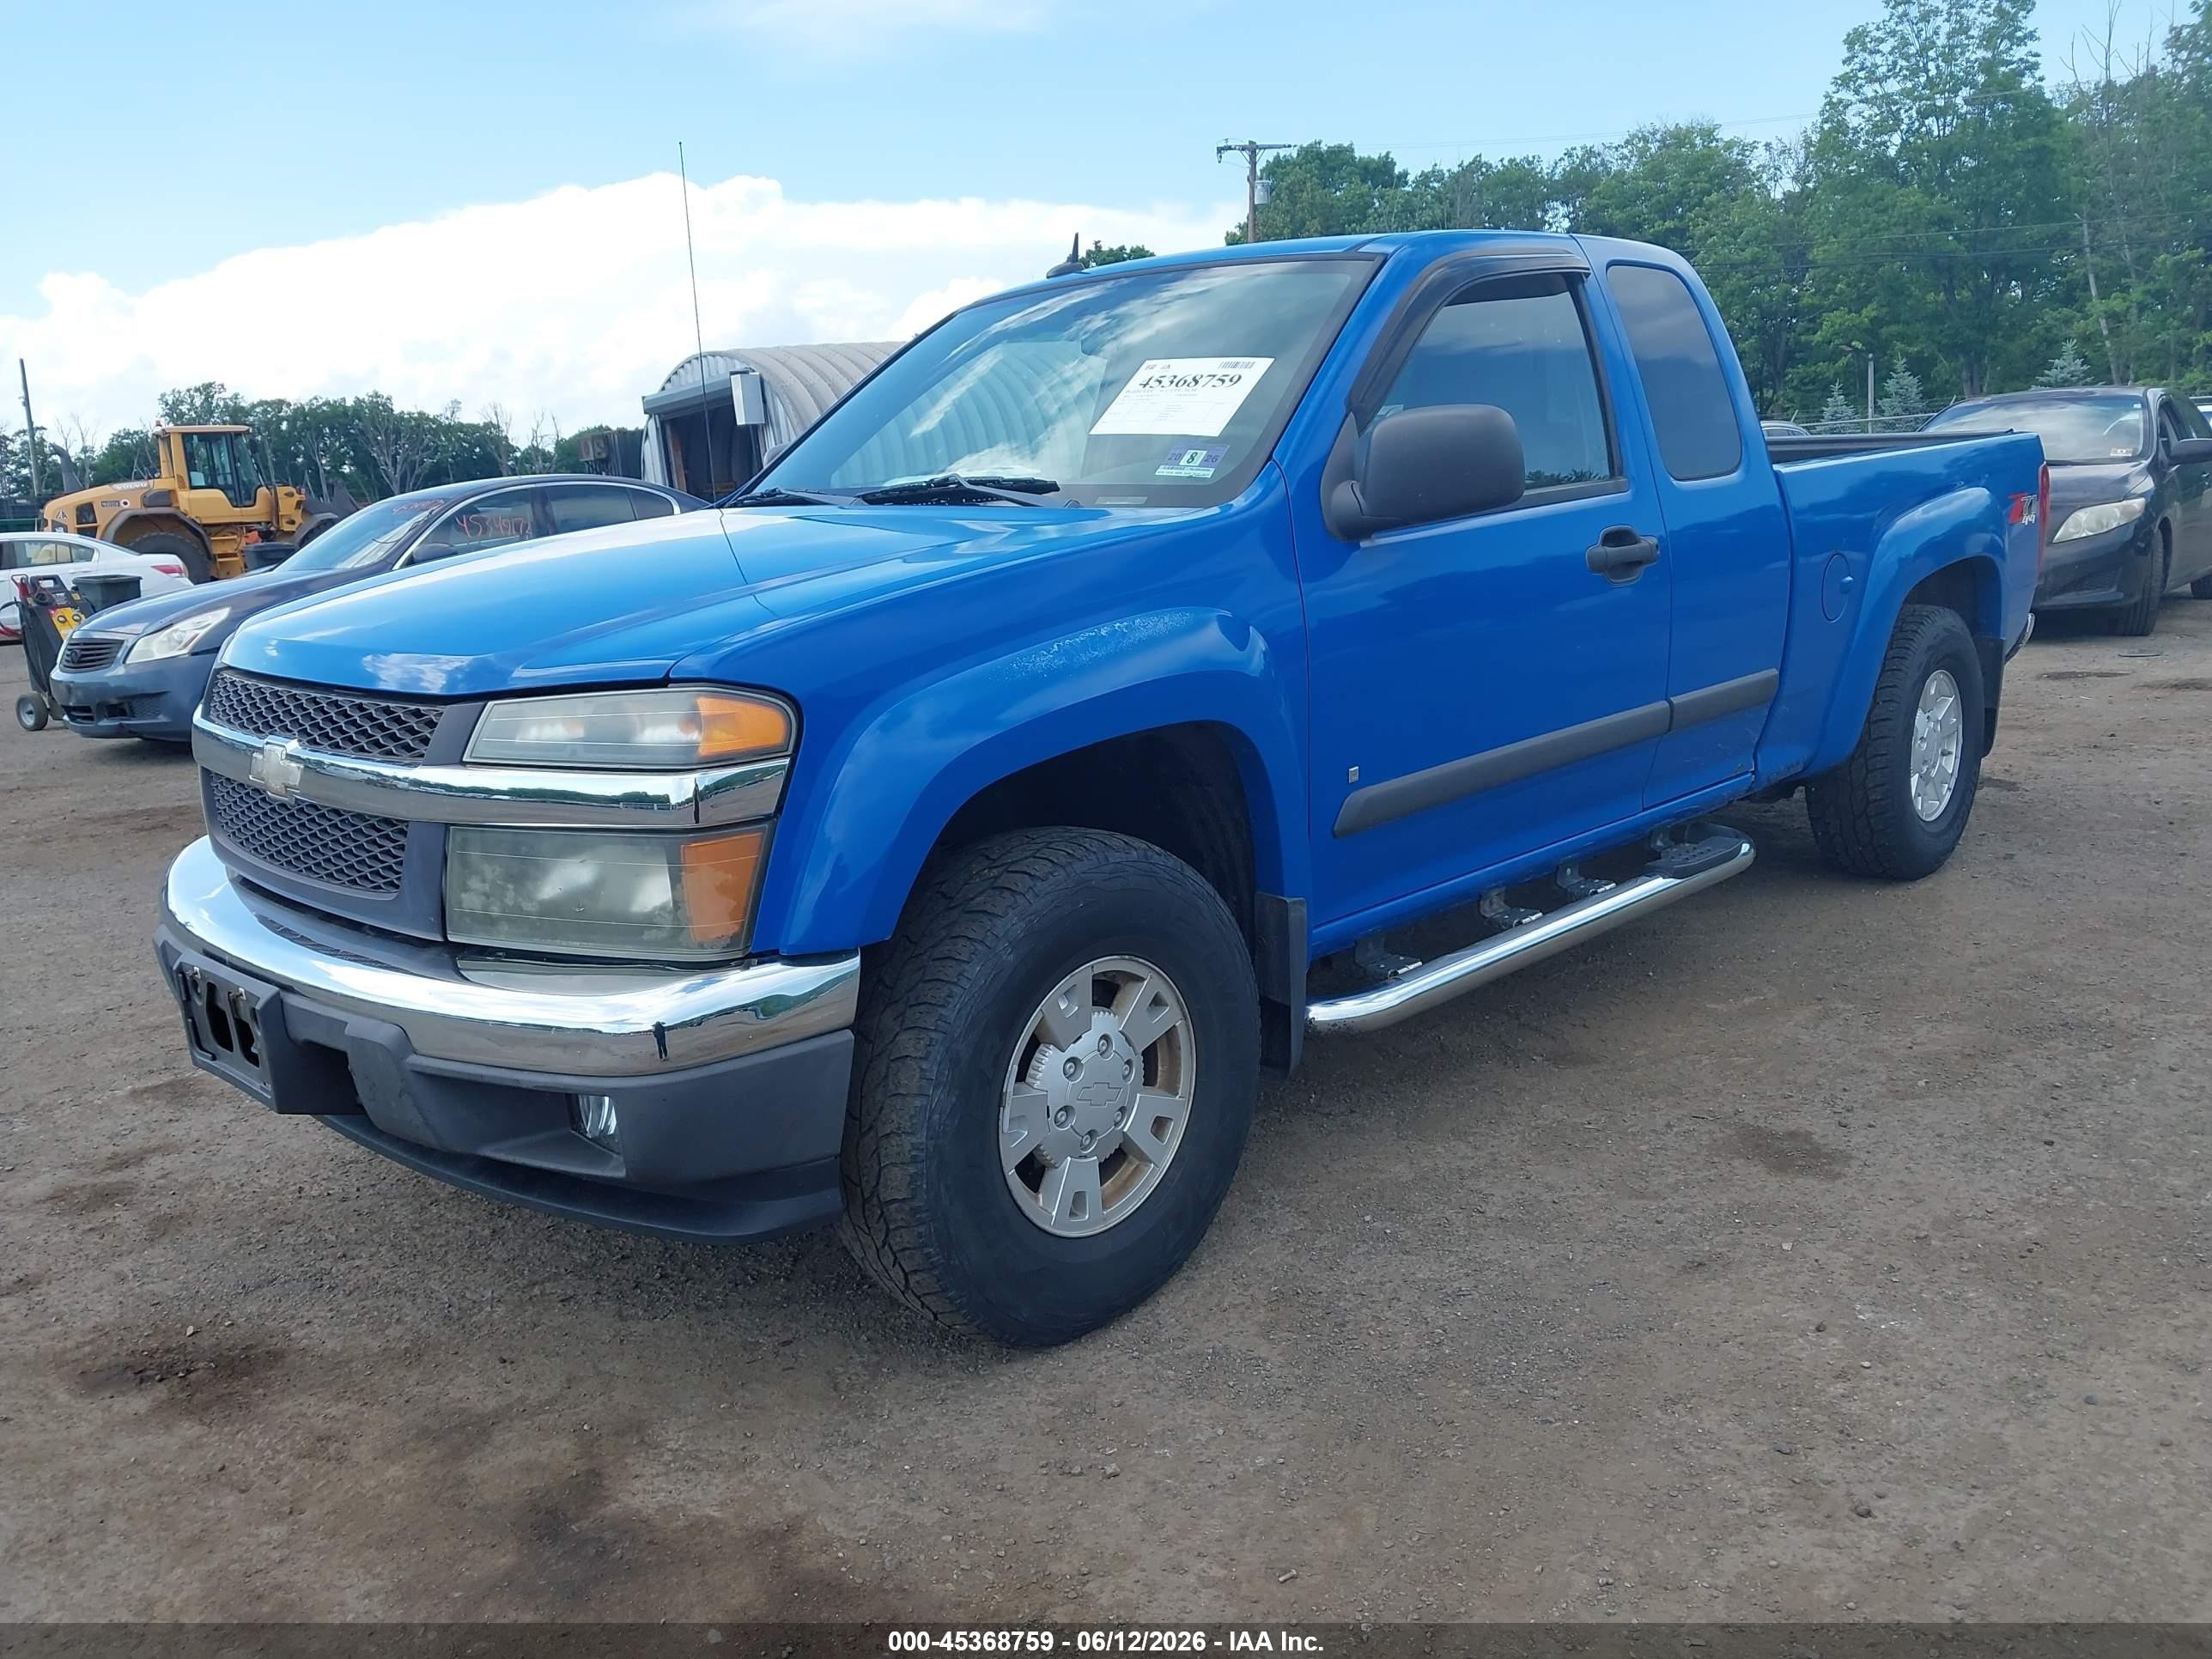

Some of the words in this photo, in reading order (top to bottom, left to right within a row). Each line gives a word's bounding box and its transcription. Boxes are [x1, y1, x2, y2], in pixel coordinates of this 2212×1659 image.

[1139, 374, 1242, 389] 45368759
[1168, 453, 1182, 461] 20
[1186, 452, 1199, 465] 8
[1203, 454, 1221, 463] 26
